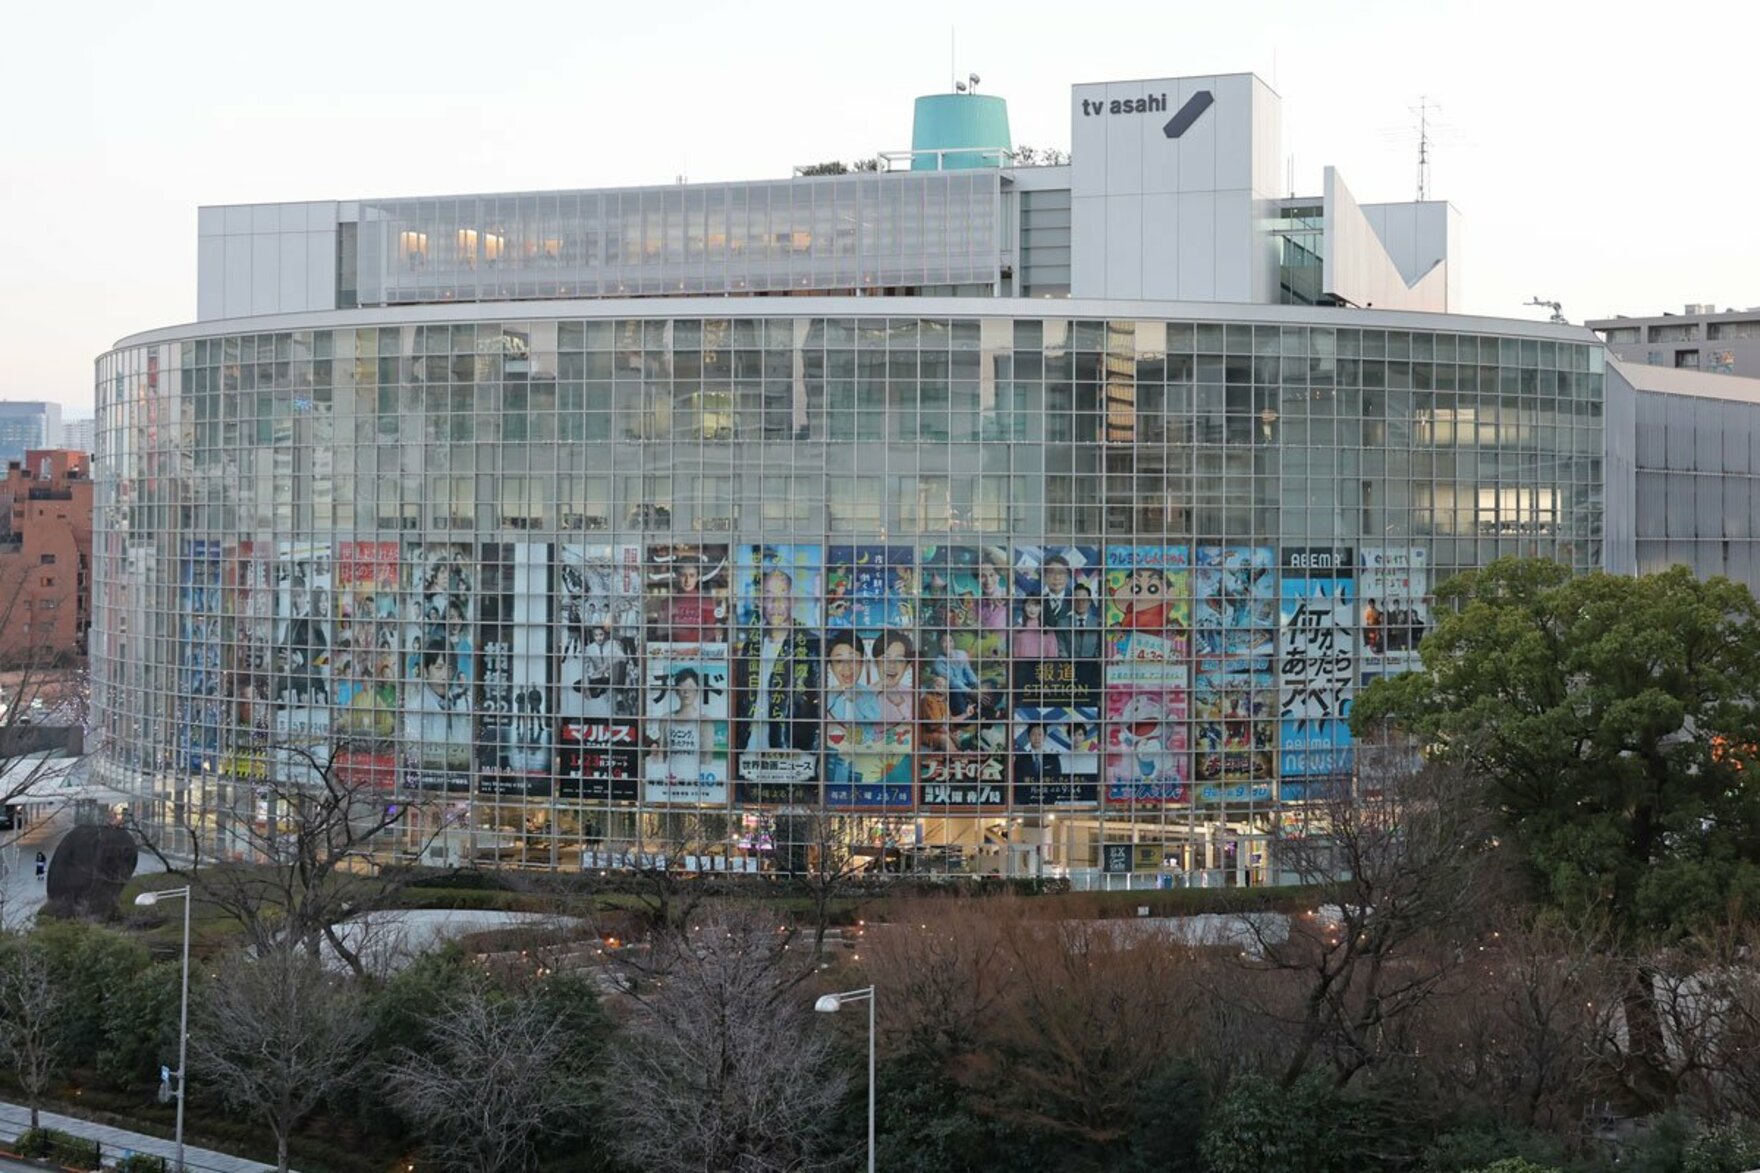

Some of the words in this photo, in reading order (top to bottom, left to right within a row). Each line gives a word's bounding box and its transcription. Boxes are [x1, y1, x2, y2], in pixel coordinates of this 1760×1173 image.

[1082, 98, 1104, 116] tv
[1109, 93, 1167, 115] asahi
[1291, 552, 1341, 567] ABEMA
[1287, 603, 1351, 651] 何か
[1282, 647, 1352, 676] あったら
[1034, 663, 1079, 681] 報道
[1023, 683, 1090, 697] STATION
[1282, 677, 1352, 711] アベマ
[567, 724, 632, 743] マルス
[742, 760, 812, 771] 世界動画ニュース
